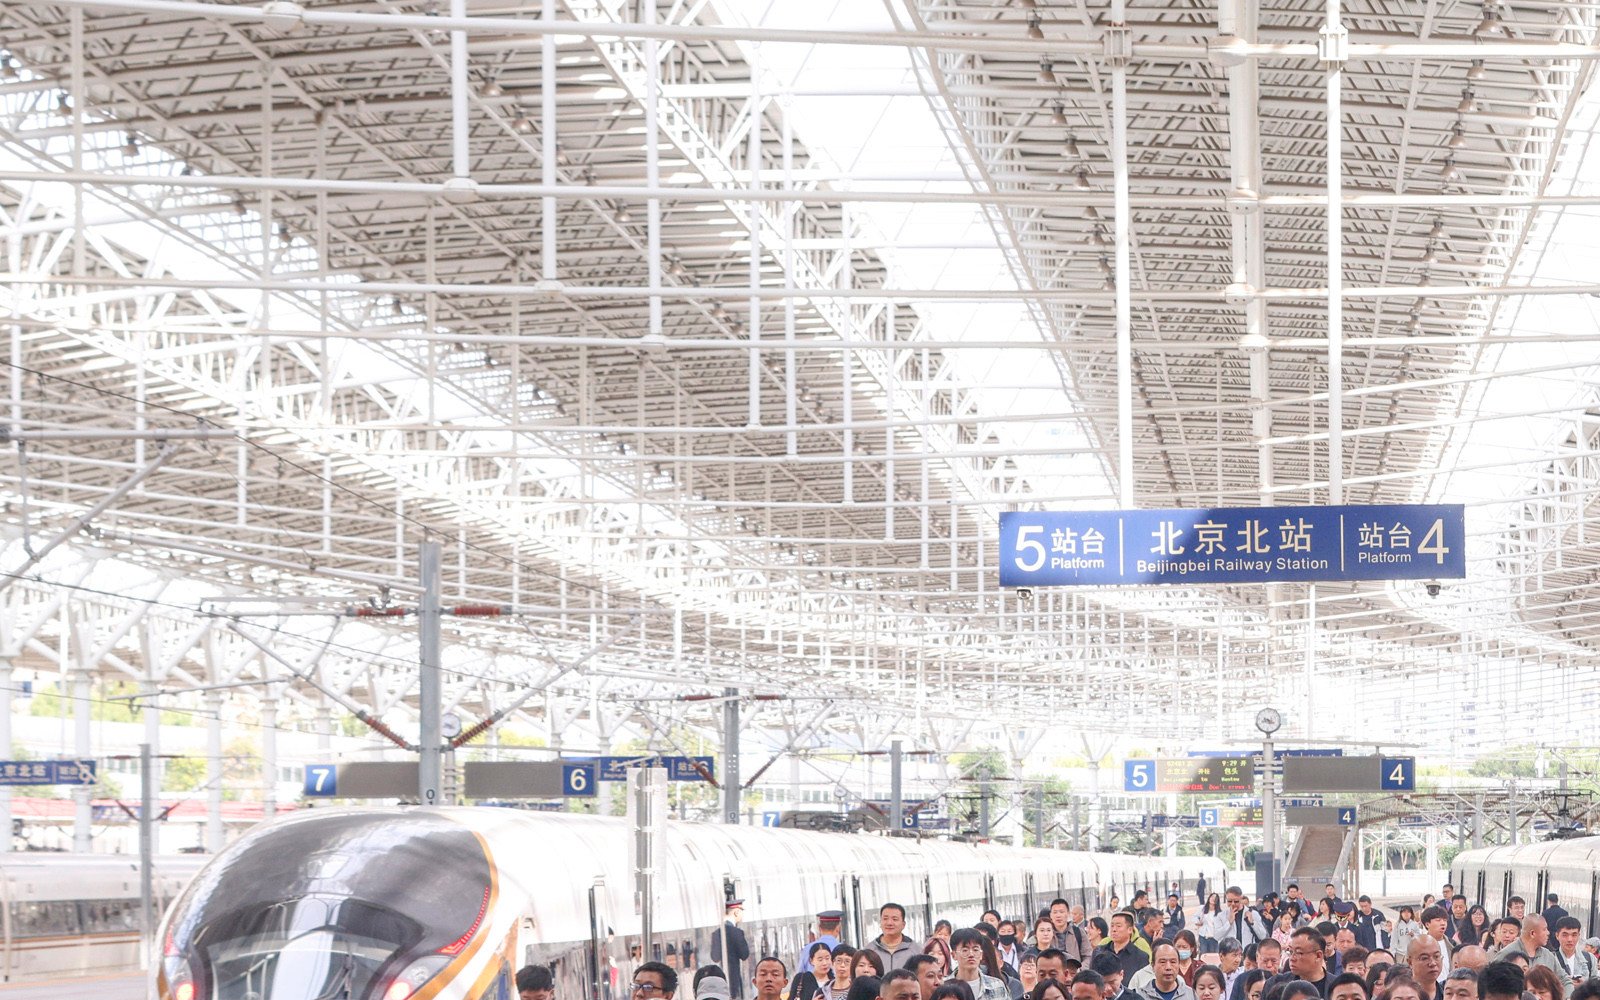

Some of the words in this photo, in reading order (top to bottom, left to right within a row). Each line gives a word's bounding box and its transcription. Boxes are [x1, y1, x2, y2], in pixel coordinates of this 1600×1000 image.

[1014, 525, 1046, 572] 5
[1051, 528, 1106, 555] 站台
[1150, 518, 1314, 556] 北京北站
[1358, 521, 1413, 550] 站台
[1417, 518, 1450, 565] 4
[1051, 556, 1105, 570] Platform
[1137, 556, 1211, 575] Beijingbei
[1214, 557, 1273, 575] Railway
[1276, 556, 1328, 572] Station
[1358, 550, 1412, 564] Platform
[312, 768, 330, 792] 7
[570, 768, 586, 791] 6
[1132, 764, 1148, 788] 5
[1389, 763, 1405, 786] 4
[765, 813, 777, 828] 7
[1204, 811, 1214, 824] 5
[1342, 810, 1351, 823] 4
